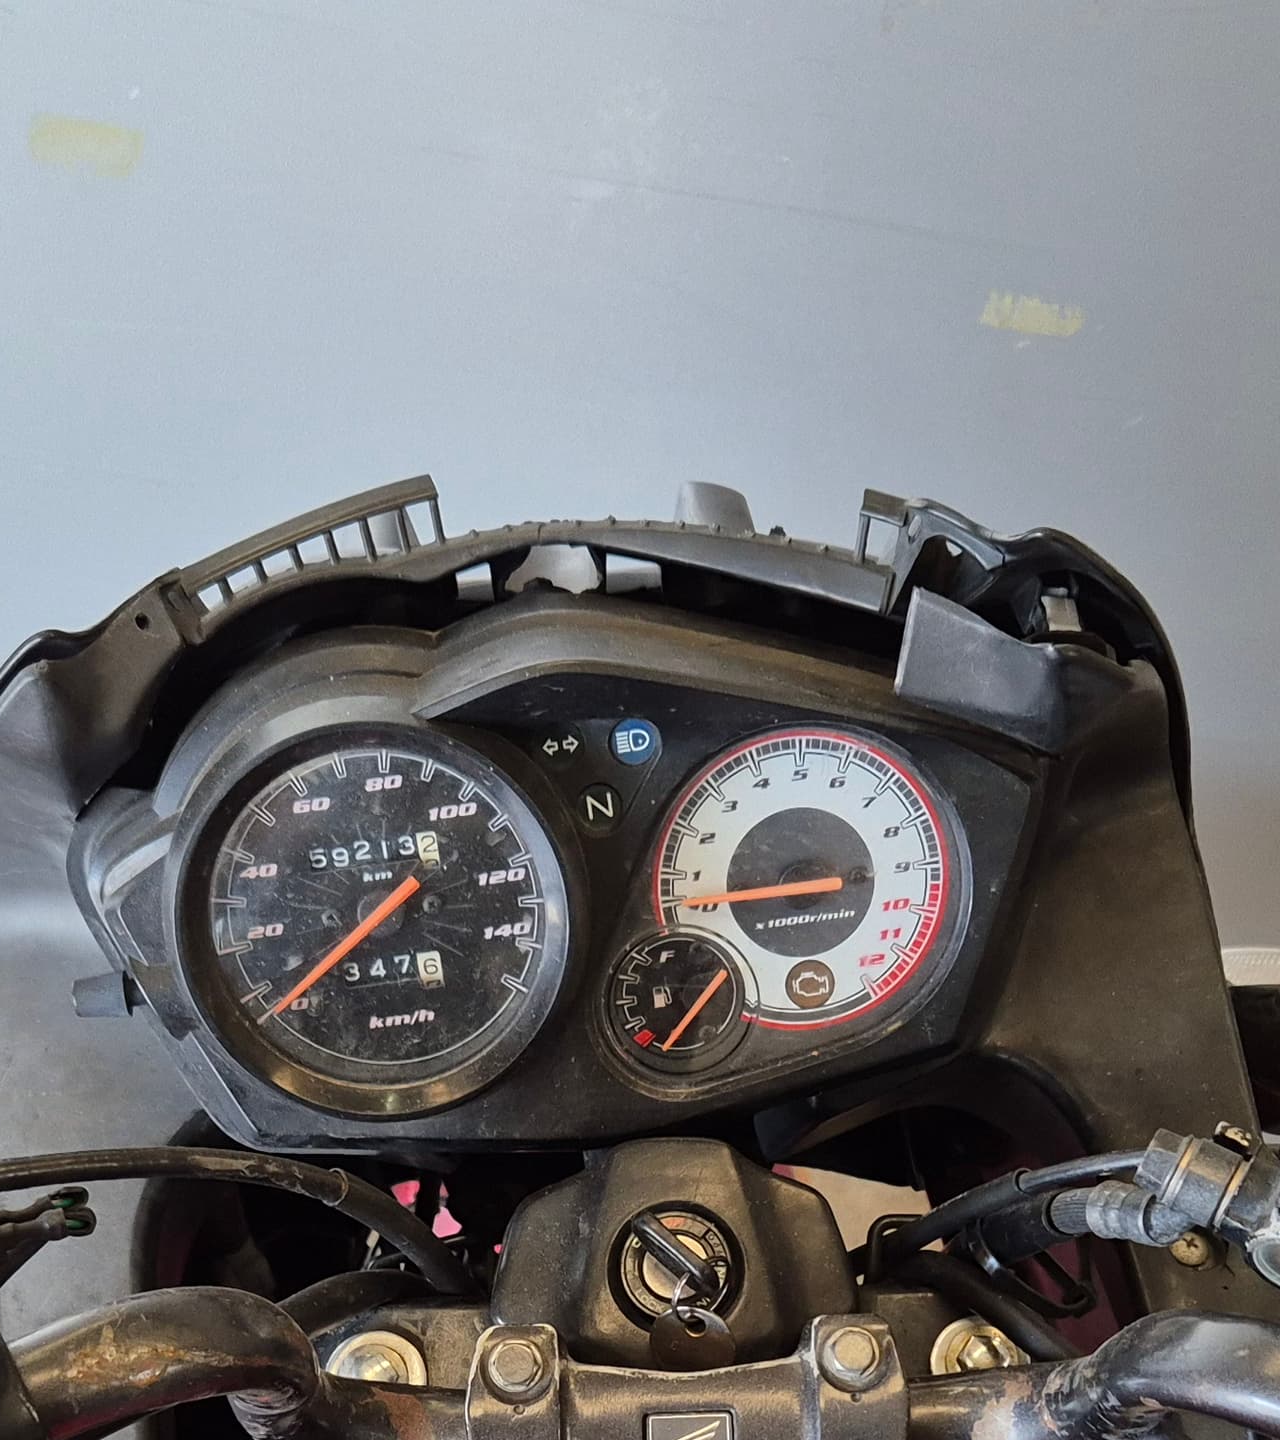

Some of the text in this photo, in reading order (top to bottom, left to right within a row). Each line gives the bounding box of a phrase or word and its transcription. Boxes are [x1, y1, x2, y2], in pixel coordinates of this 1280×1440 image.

[792, 767, 809, 783] 5
[365, 774, 403, 792] 80
[752, 777, 770, 790] 4
[828, 776, 846, 789] 6
[292, 796, 331, 815] 60
[585, 791, 615, 822] N
[721, 800, 739, 813] 3
[862, 796, 876, 809] 7
[428, 802, 478, 821] 100
[699, 832, 717, 845] 2
[882, 826, 901, 838] 8
[239, 863, 279, 879] 40
[893, 862, 912, 874] 9
[362, 871, 393, 882] km
[477, 867, 526, 886] 120
[692, 870, 702, 881] 1
[881, 898, 911, 911] 10
[247, 923, 285, 940] 20
[483, 922, 532, 940] 140
[878, 927, 902, 941] 11
[659, 950, 676, 963] F
[857, 953, 886, 967] 12
[290, 997, 309, 1011] 0
[369, 1009, 436, 1030] km/h
